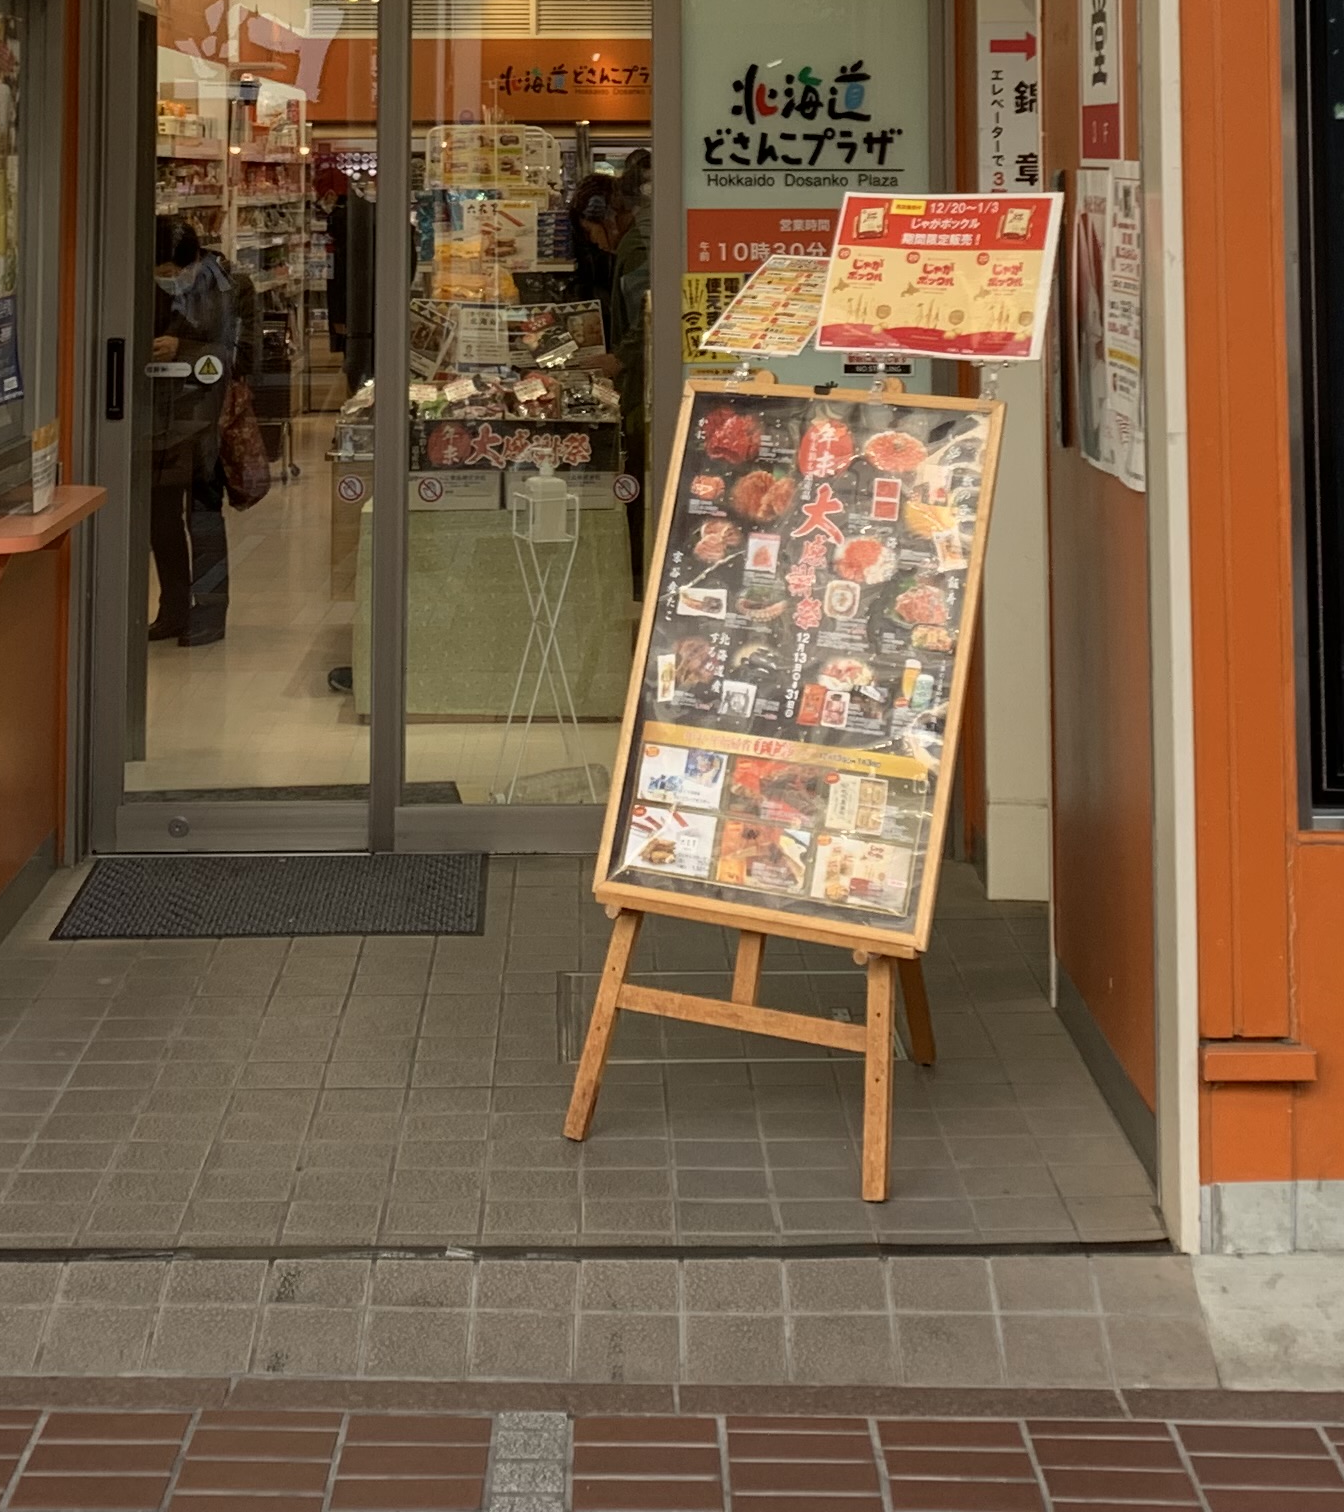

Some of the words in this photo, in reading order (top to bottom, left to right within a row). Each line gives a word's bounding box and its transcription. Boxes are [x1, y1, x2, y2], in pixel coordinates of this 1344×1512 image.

[731, 60, 871, 125] 北海道
[704, 127, 903, 166] どさんこプラザ
[707, 173, 775, 187] Hokkaido
[784, 173, 849, 187] Dosanko
[858, 173, 899, 187] Plaza
[779, 219, 831, 232] 営業時間
